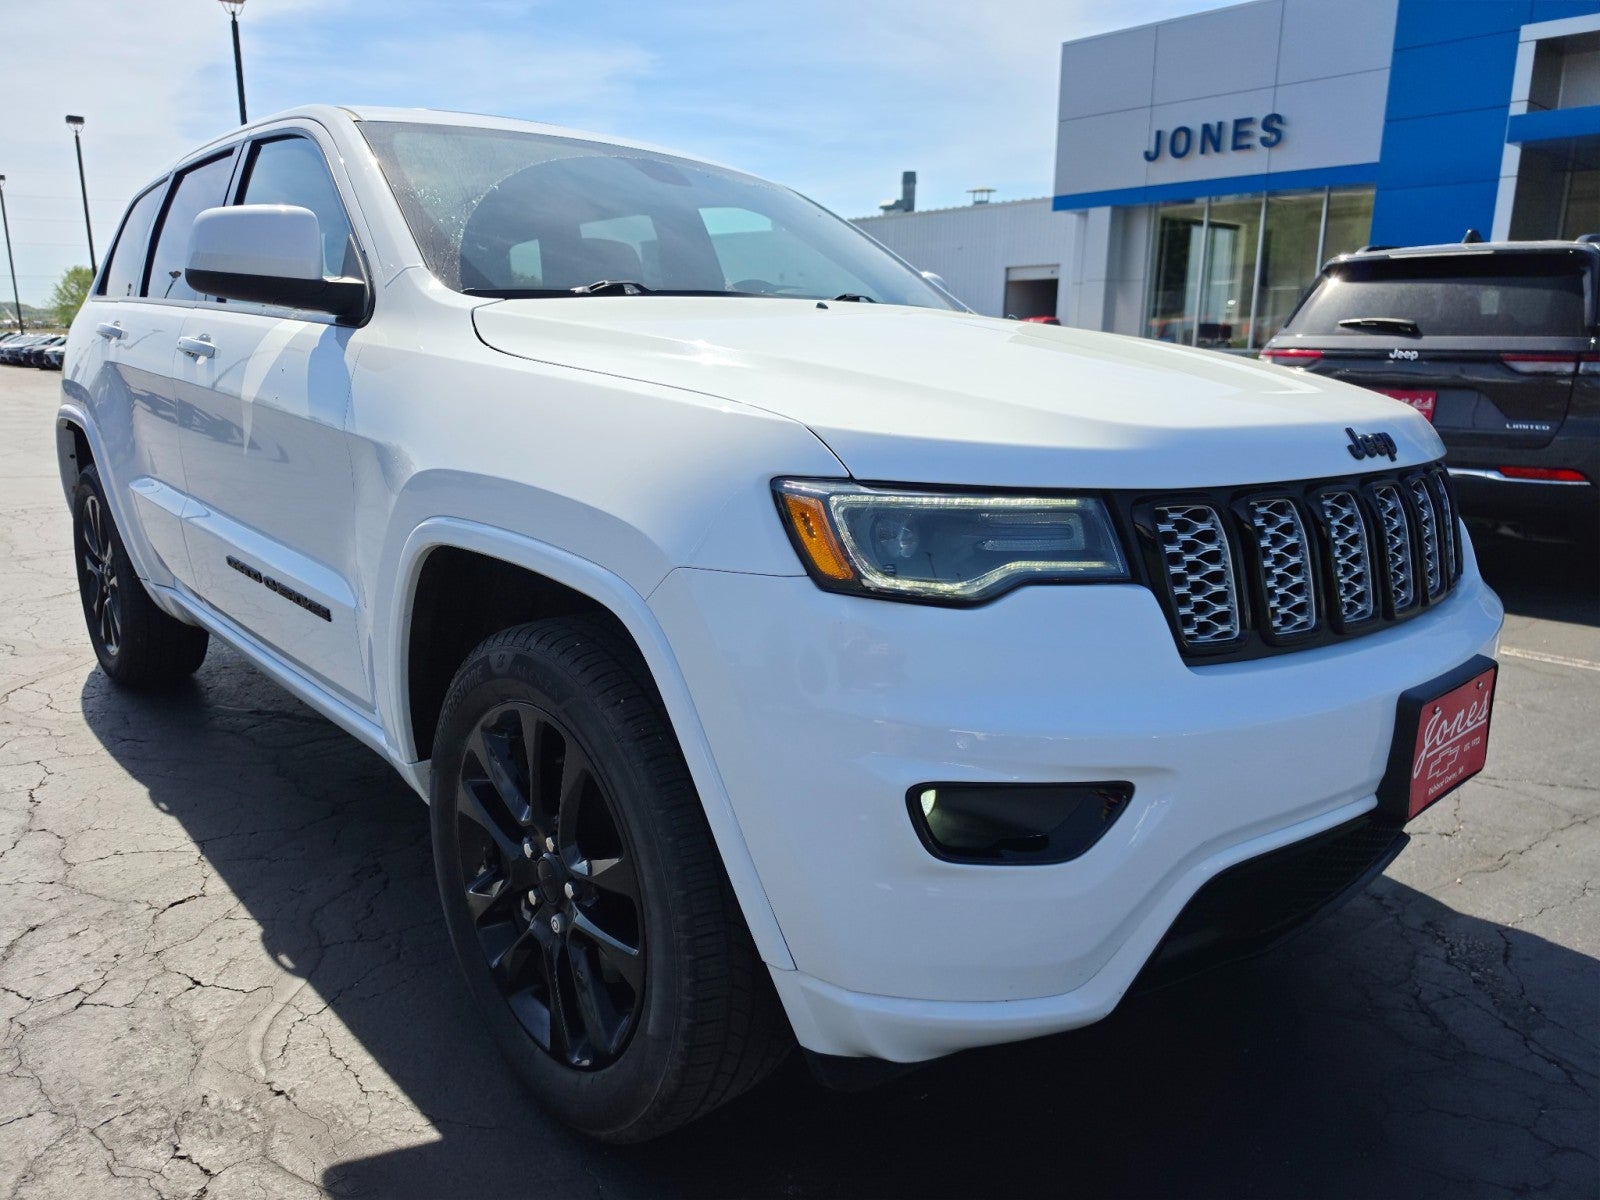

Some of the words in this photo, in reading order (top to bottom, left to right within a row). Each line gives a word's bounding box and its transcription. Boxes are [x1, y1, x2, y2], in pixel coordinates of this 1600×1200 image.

[1143, 113, 1285, 162] JONES
[1389, 348, 1419, 361] Jeep
[1345, 427, 1398, 462] Jeep
[1506, 423, 1550, 431] LIMITED
[1413, 690, 1489, 779] Jones
